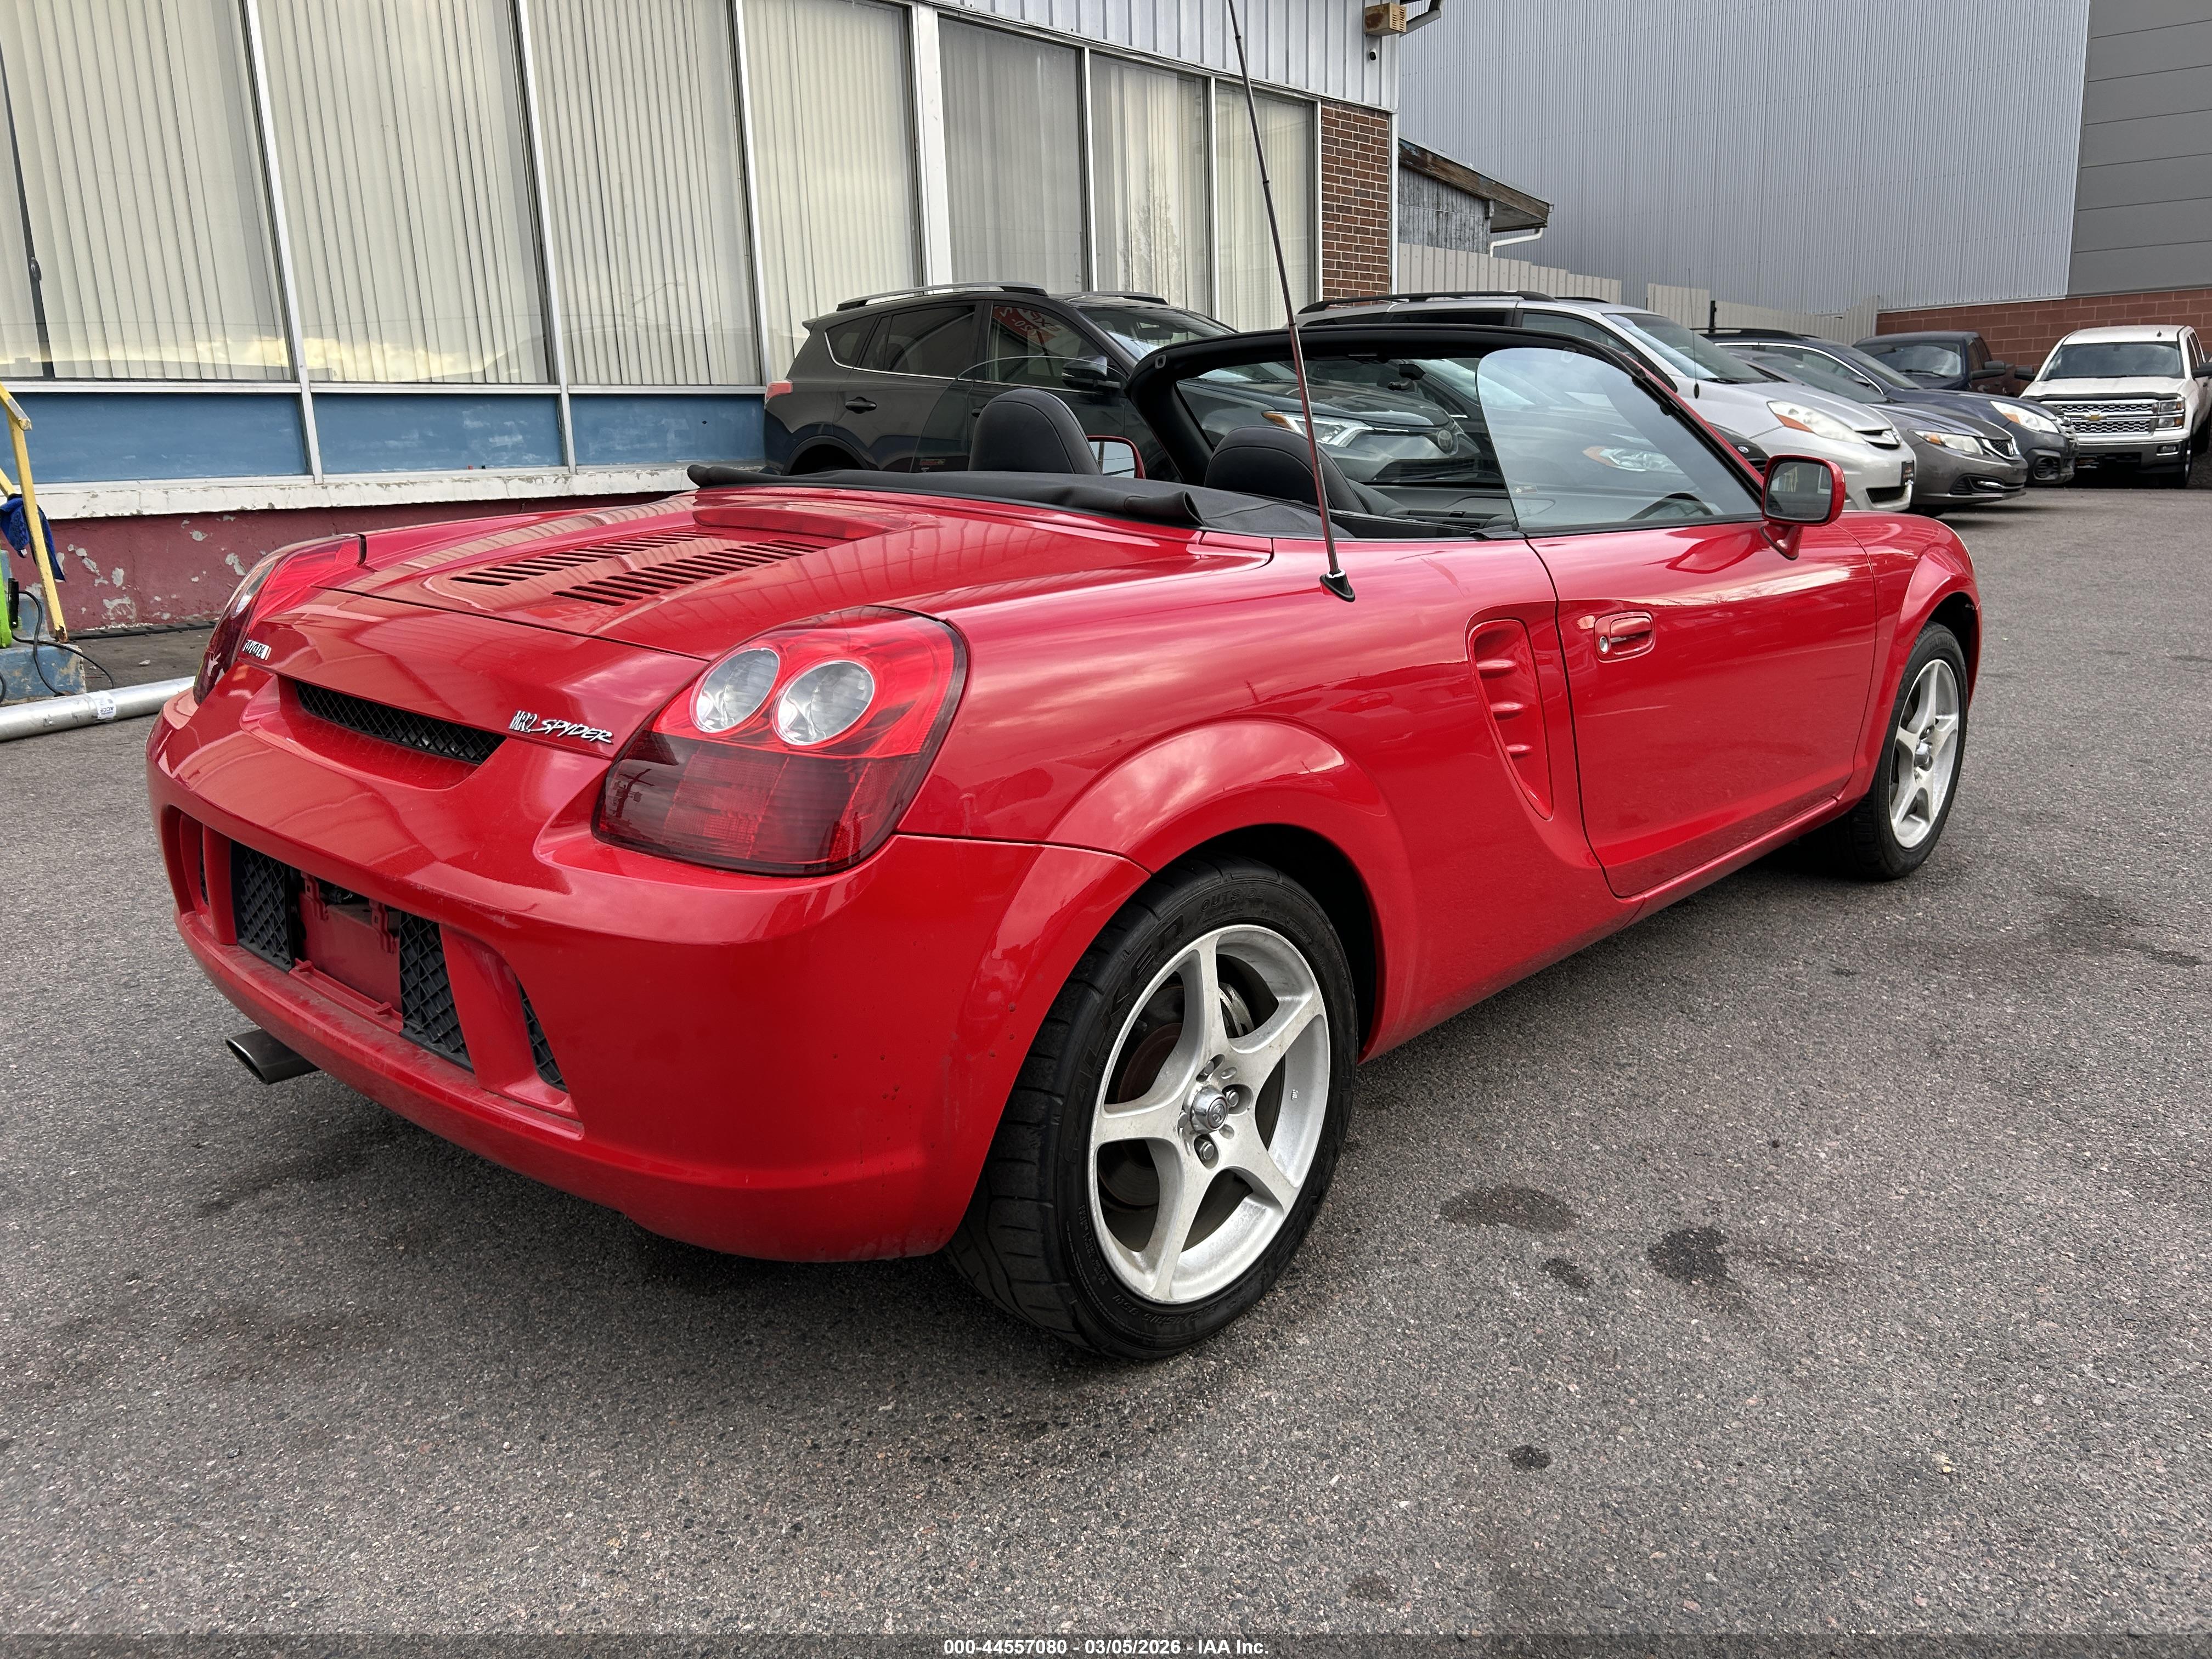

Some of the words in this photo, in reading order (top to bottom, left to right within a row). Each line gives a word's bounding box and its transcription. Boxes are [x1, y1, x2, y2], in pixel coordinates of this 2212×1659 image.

[242, 639, 272, 661] TOYOTA
[509, 710, 538, 733] MR2
[531, 719, 614, 743] SPYDER
[1199, 886, 1268, 913] OUTSIDE
